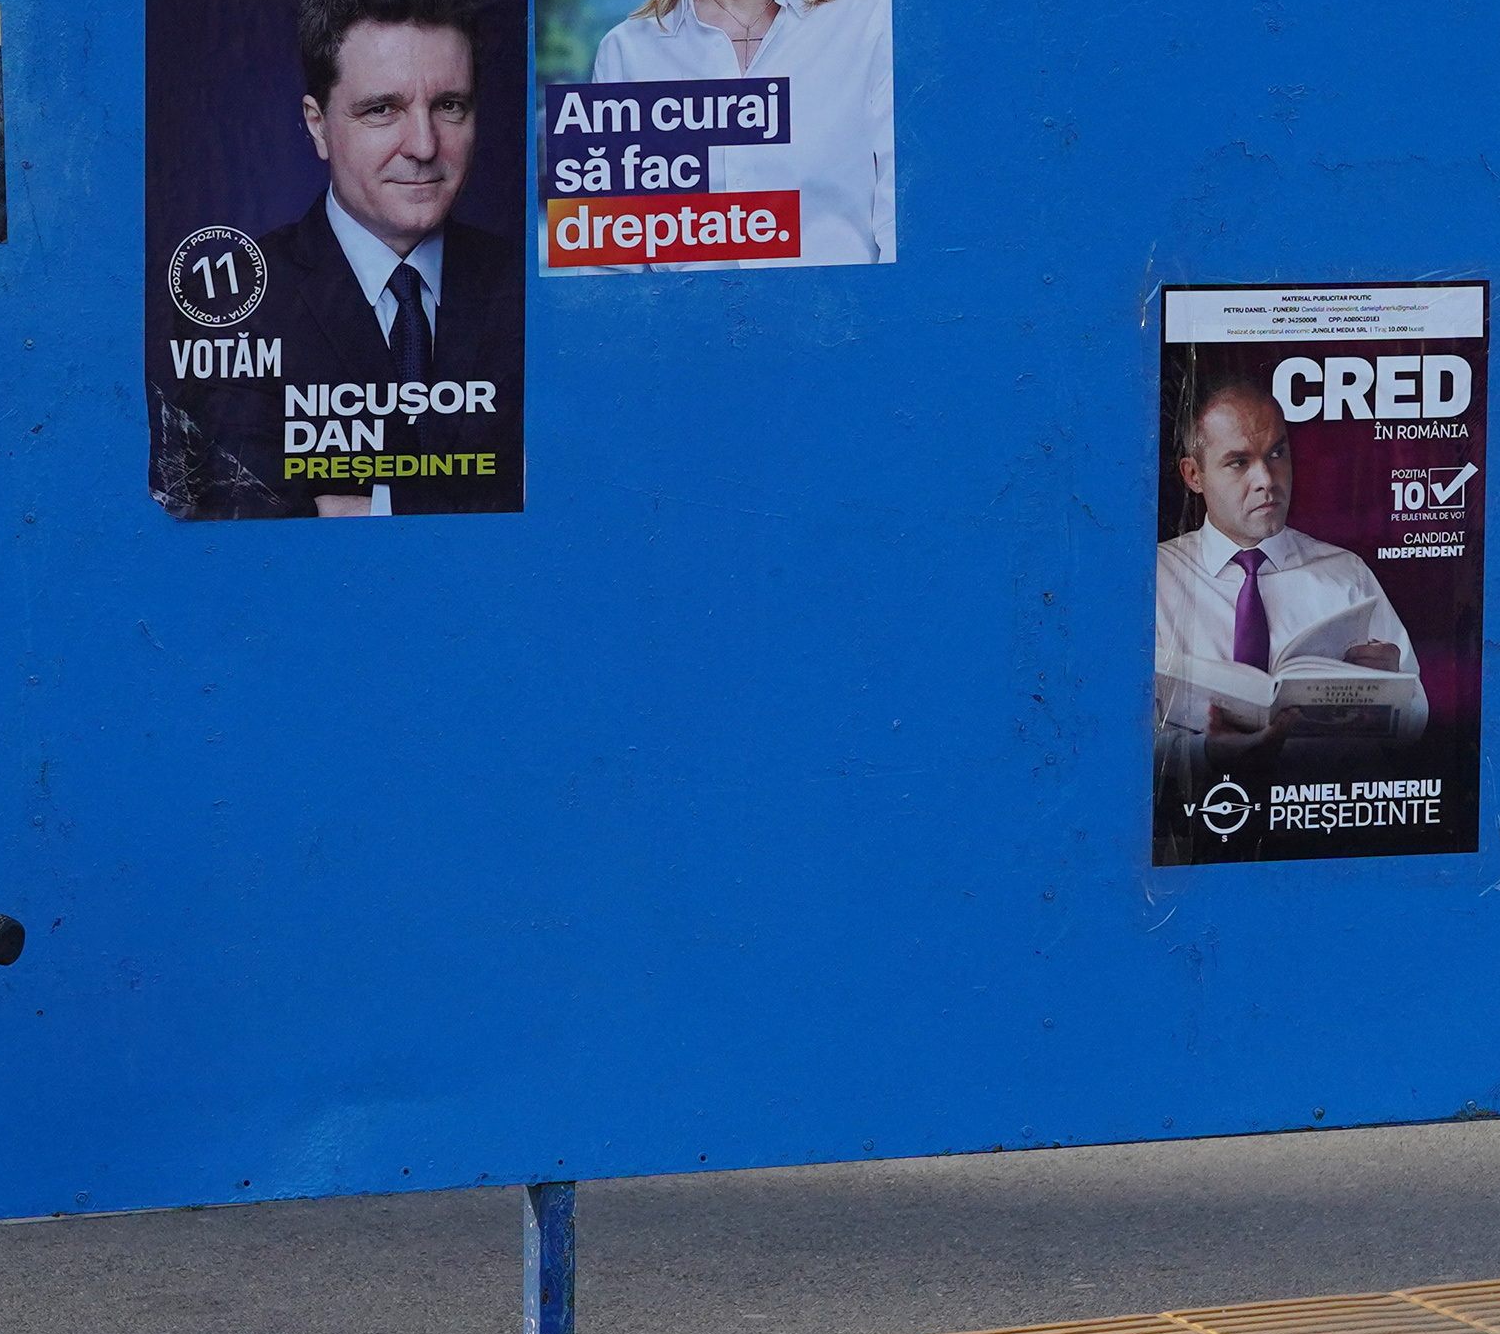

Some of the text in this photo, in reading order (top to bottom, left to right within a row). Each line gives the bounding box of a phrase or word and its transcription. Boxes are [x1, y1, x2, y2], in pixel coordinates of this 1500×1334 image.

[553, 82, 779, 139] Am curaj
[555, 144, 701, 193] să fac
[190, 229, 232, 246] POZIȚIA
[555, 204, 790, 258] dreptate.
[192, 252, 240, 300] 11
[170, 331, 282, 379] VOTĂM
[285, 380, 497, 425] NICUȘOR
[1272, 354, 1473, 423] CRED
[285, 418, 385, 453] DAN
[1374, 421, 1469, 441] ÎN ROMÂNIA
[284, 453, 497, 485] PREȘEDINTE
[1391, 468, 1428, 481] POZIȚIA
[1391, 482, 1426, 511] 10
[1391, 514, 1400, 522] PE
[1401, 513, 1438, 521] BULETINUL
[1450, 512, 1466, 520] VOT
[1377, 545, 1466, 560] INDEPENDENT
[1403, 531, 1465, 545] CANDIDAT
[1223, 774, 1230, 782] N
[1270, 779, 1442, 804] DANIEL FUNERIU
[1183, 804, 1196, 817] V
[1269, 800, 1441, 834] PREȘEDINTE
